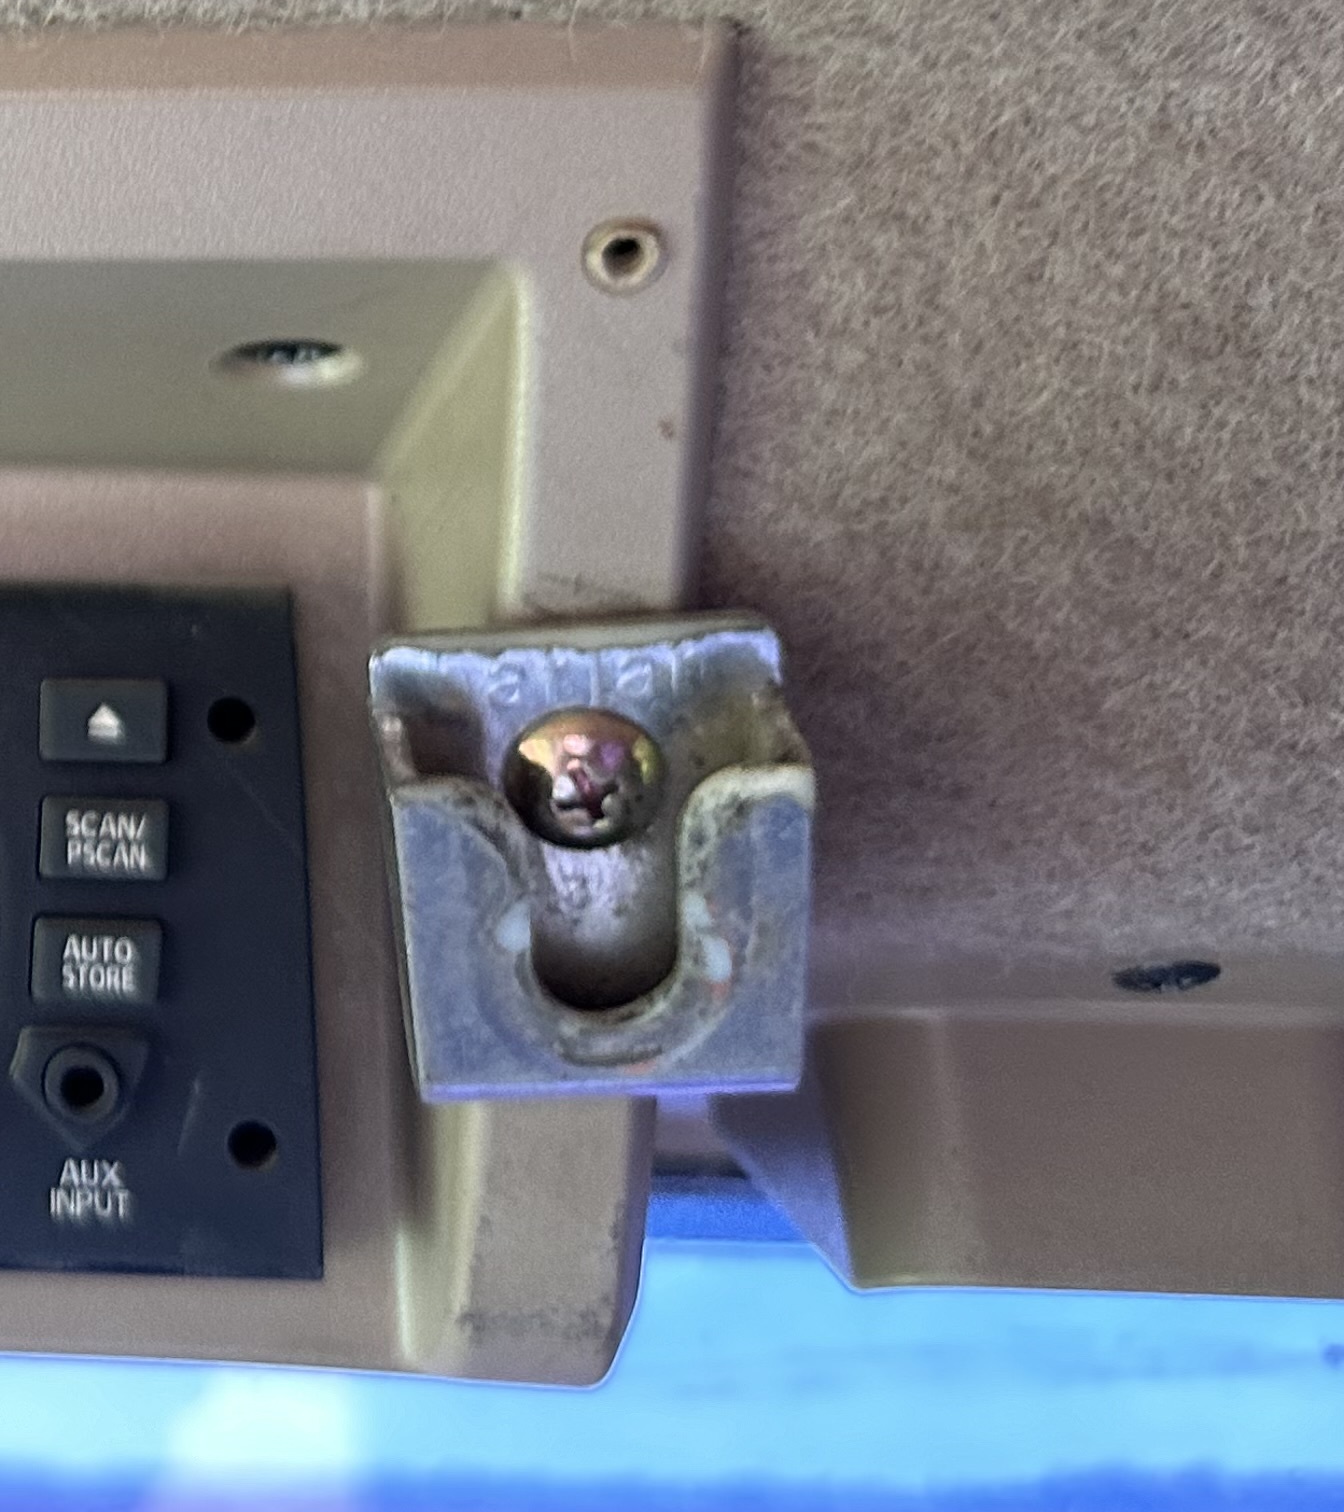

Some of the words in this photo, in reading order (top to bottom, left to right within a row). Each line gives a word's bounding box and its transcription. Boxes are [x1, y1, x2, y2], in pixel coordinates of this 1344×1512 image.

[65, 808, 147, 840] SCAN/
[66, 839, 147, 872] PSCAN
[63, 933, 134, 964] AUTO
[62, 962, 137, 994] STORE
[59, 1157, 125, 1187] AUX
[50, 1186, 131, 1220] INPUT
